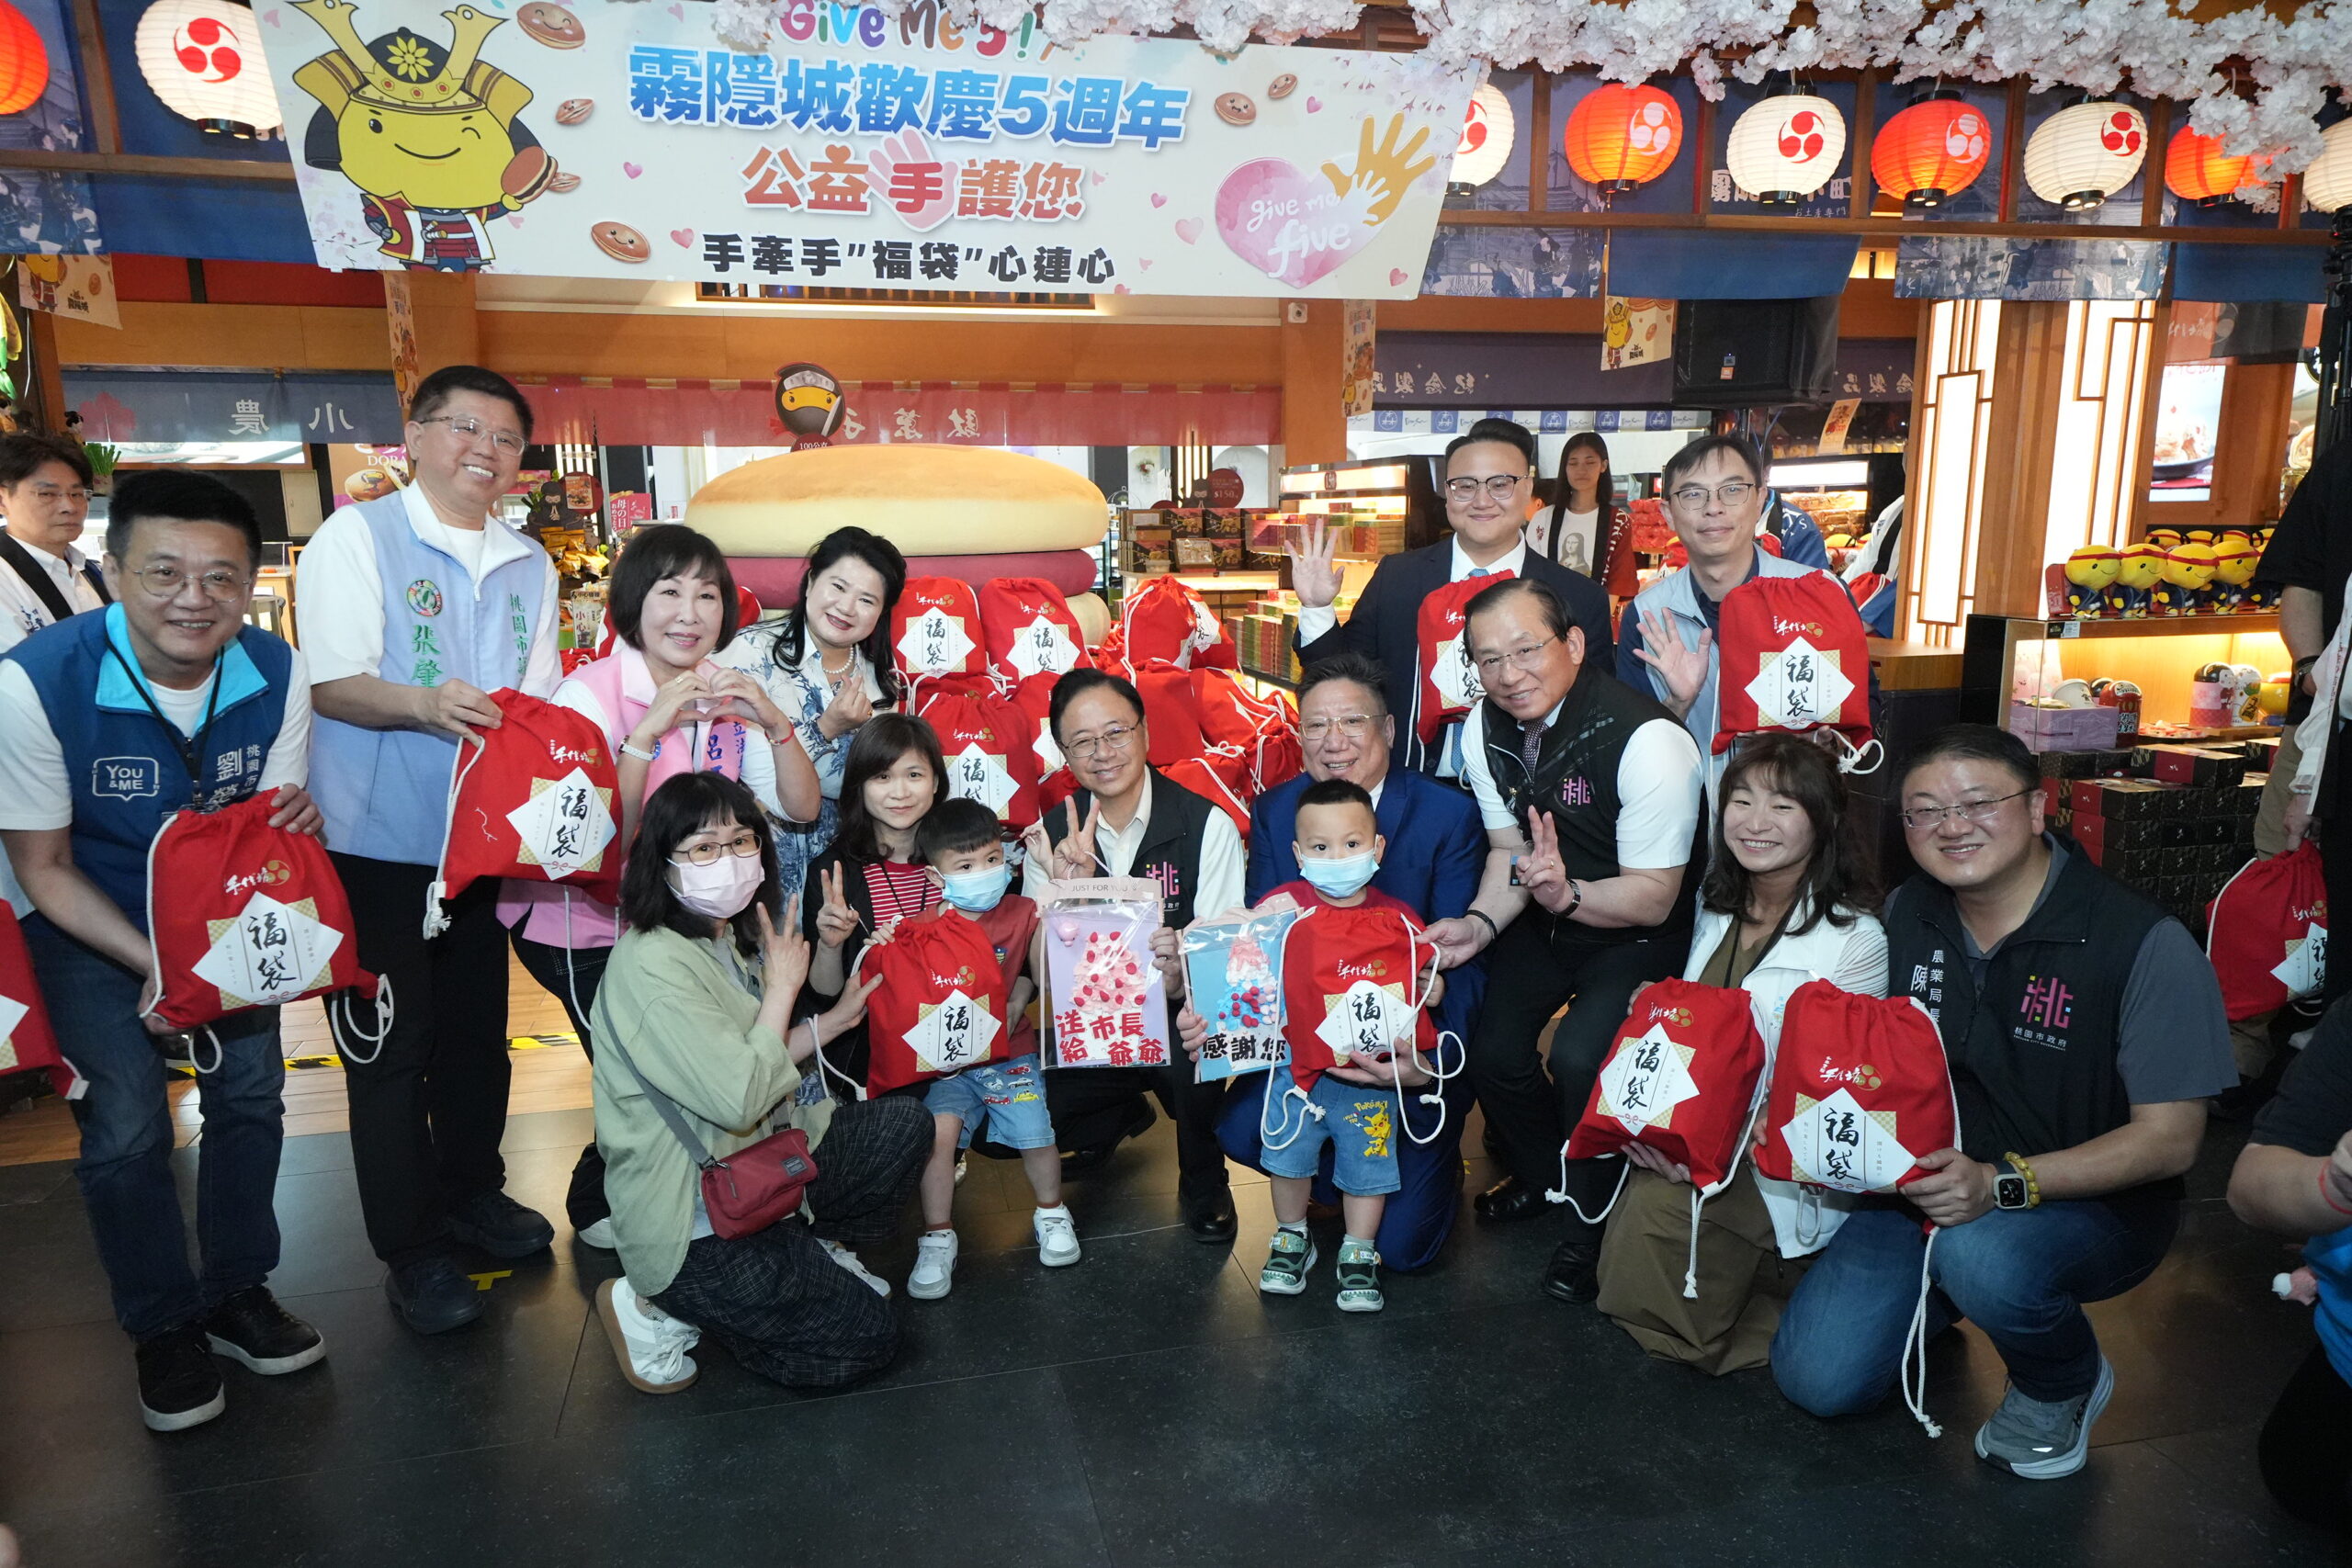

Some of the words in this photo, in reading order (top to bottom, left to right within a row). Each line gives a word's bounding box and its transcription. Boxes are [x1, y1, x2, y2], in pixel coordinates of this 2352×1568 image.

[780, 0, 886, 47] Give
[628, 46, 1190, 150] 霧隱城歡慶5週年
[741, 144, 1085, 221] 公益手護您
[1247, 199, 1299, 232] give
[1306, 193, 1340, 211] me
[1267, 219, 1352, 278] five
[616, 499, 627, 528] 母の日
[925, 617, 947, 666] 福袋
[1034, 627, 1057, 672] 福袋
[1786, 654, 1815, 717] 福袋
[551, 785, 588, 858] 福袋
[1092, 884, 1109, 892] FOR
[247, 912, 297, 991] 福袋
[1910, 964, 1928, 993] 陳
[1929, 949, 1945, 1023] 農業局長
[944, 1006, 969, 1062] 福袋
[1203, 1032, 1286, 1062] 感謝您
[1351, 992, 1387, 1053] 福袋
[2014, 1026, 2067, 1047] 桃園市政府
[1623, 1040, 1661, 1110] 福袋
[1824, 1107, 1862, 1181] 福袋
